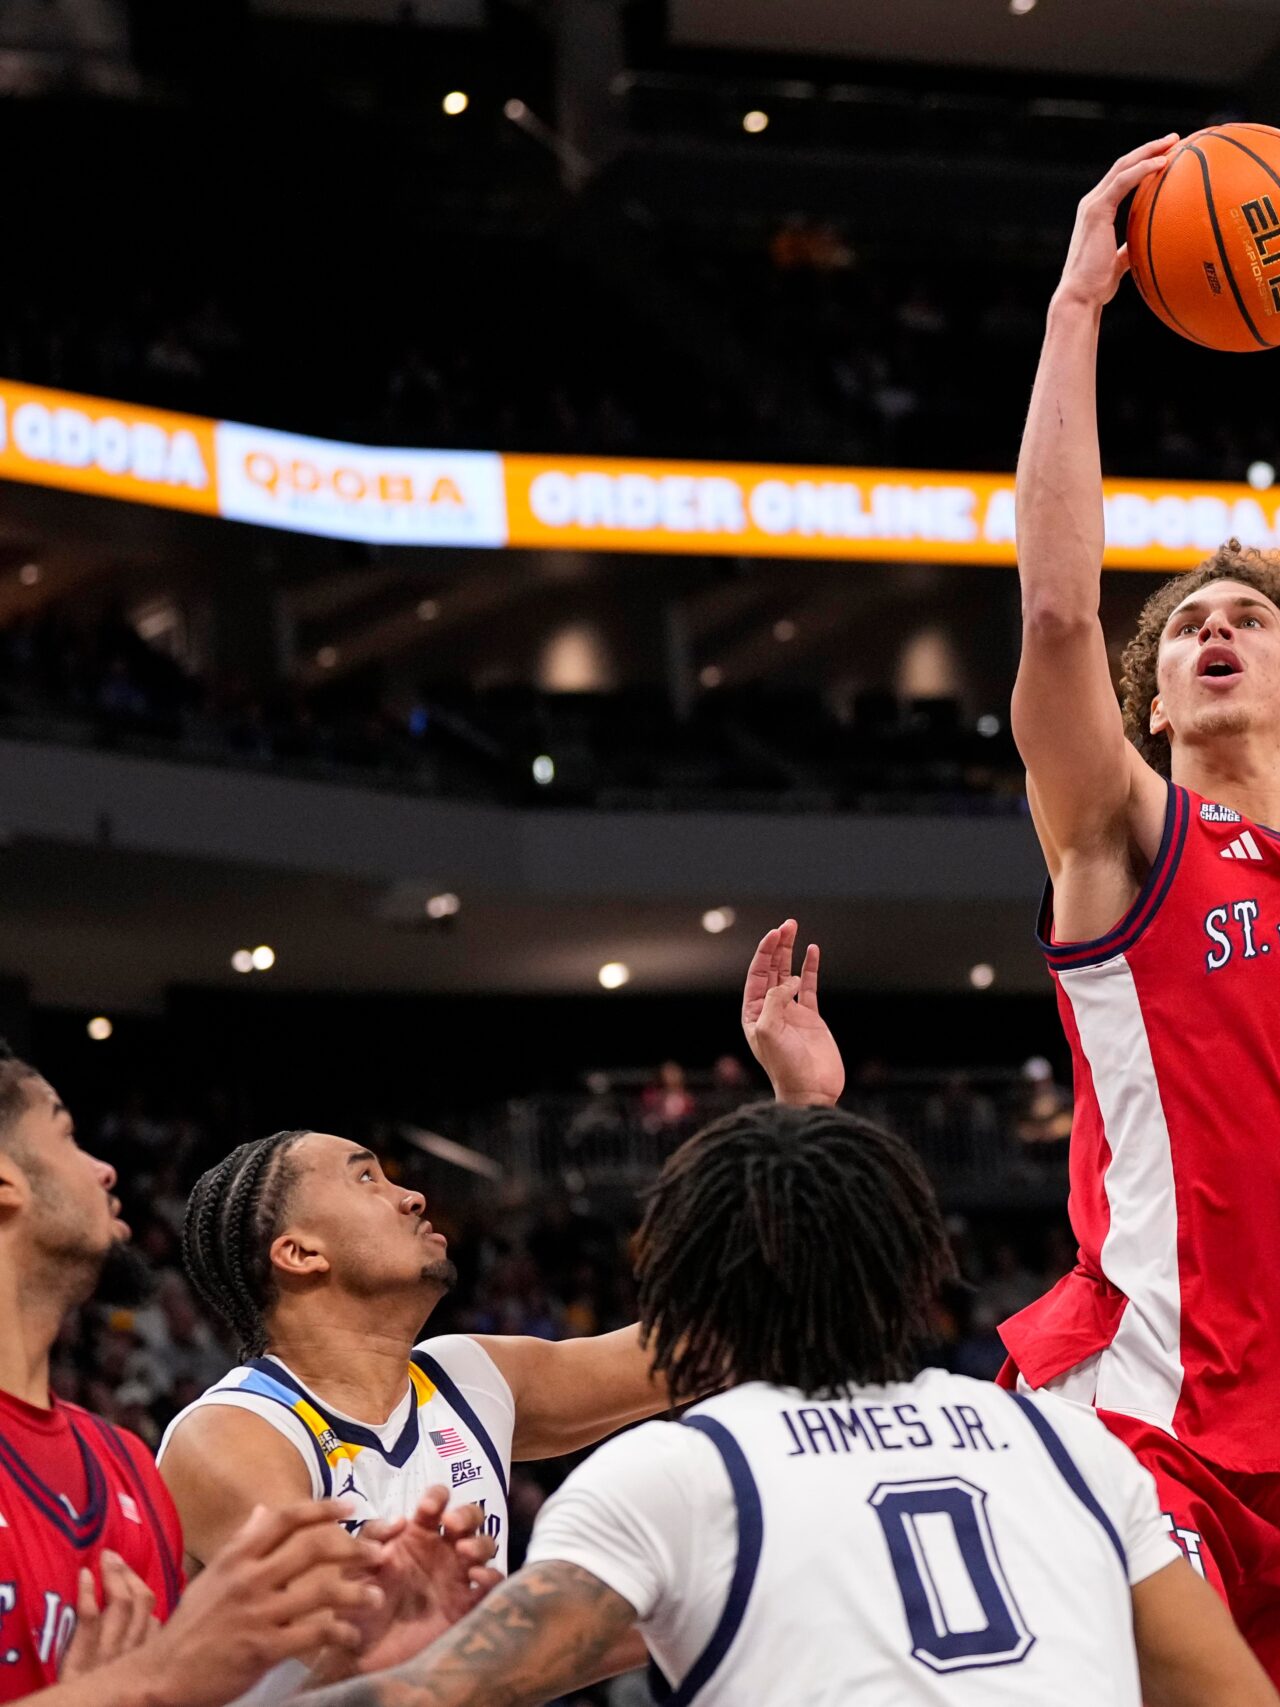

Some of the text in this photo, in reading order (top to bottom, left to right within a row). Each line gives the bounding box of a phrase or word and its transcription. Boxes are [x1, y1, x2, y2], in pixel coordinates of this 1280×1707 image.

[12, 402, 207, 489] QDOBA
[244, 451, 464, 504] QDOBA
[529, 471, 745, 534] ORDER
[749, 480, 978, 543] ONLINE
[1200, 811, 1241, 822] CHANGE
[1201, 803, 1216, 812] BE
[1205, 900, 1269, 974] ST.
[781, 1403, 1010, 1456] JAMES JR.
[451, 1459, 472, 1473] BIG
[452, 1466, 482, 1483] EAST
[867, 1476, 1037, 1674] 0
